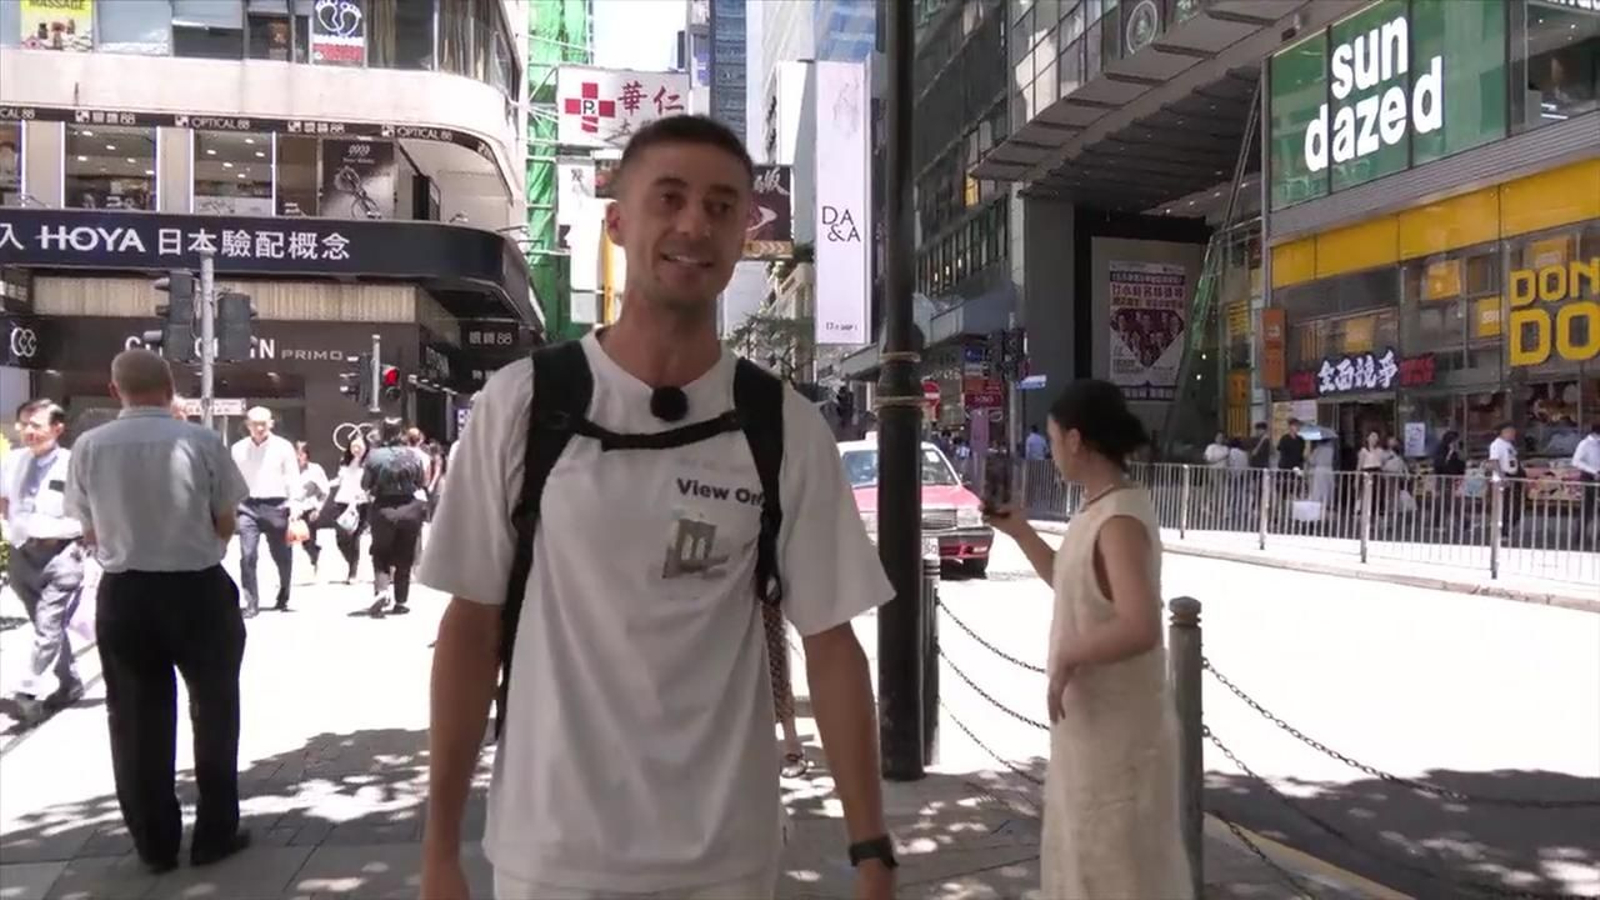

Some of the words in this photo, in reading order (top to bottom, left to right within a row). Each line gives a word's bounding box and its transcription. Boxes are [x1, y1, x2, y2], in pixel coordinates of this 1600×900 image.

[1331, 16, 1408, 100] sun
[618, 80, 684, 116] 華仁
[191, 117, 236, 130] OPTICAL
[1304, 56, 1443, 172] dazed
[397, 126, 440, 141] OPTICAL
[822, 205, 854, 226] DA
[36, 225, 146, 253] HOYA
[158, 228, 351, 261] 日本驗配概念
[827, 223, 861, 242] &A
[1510, 257, 1599, 308] DON
[281, 349, 343, 361] PRIMO
[677, 477, 730, 501] View
